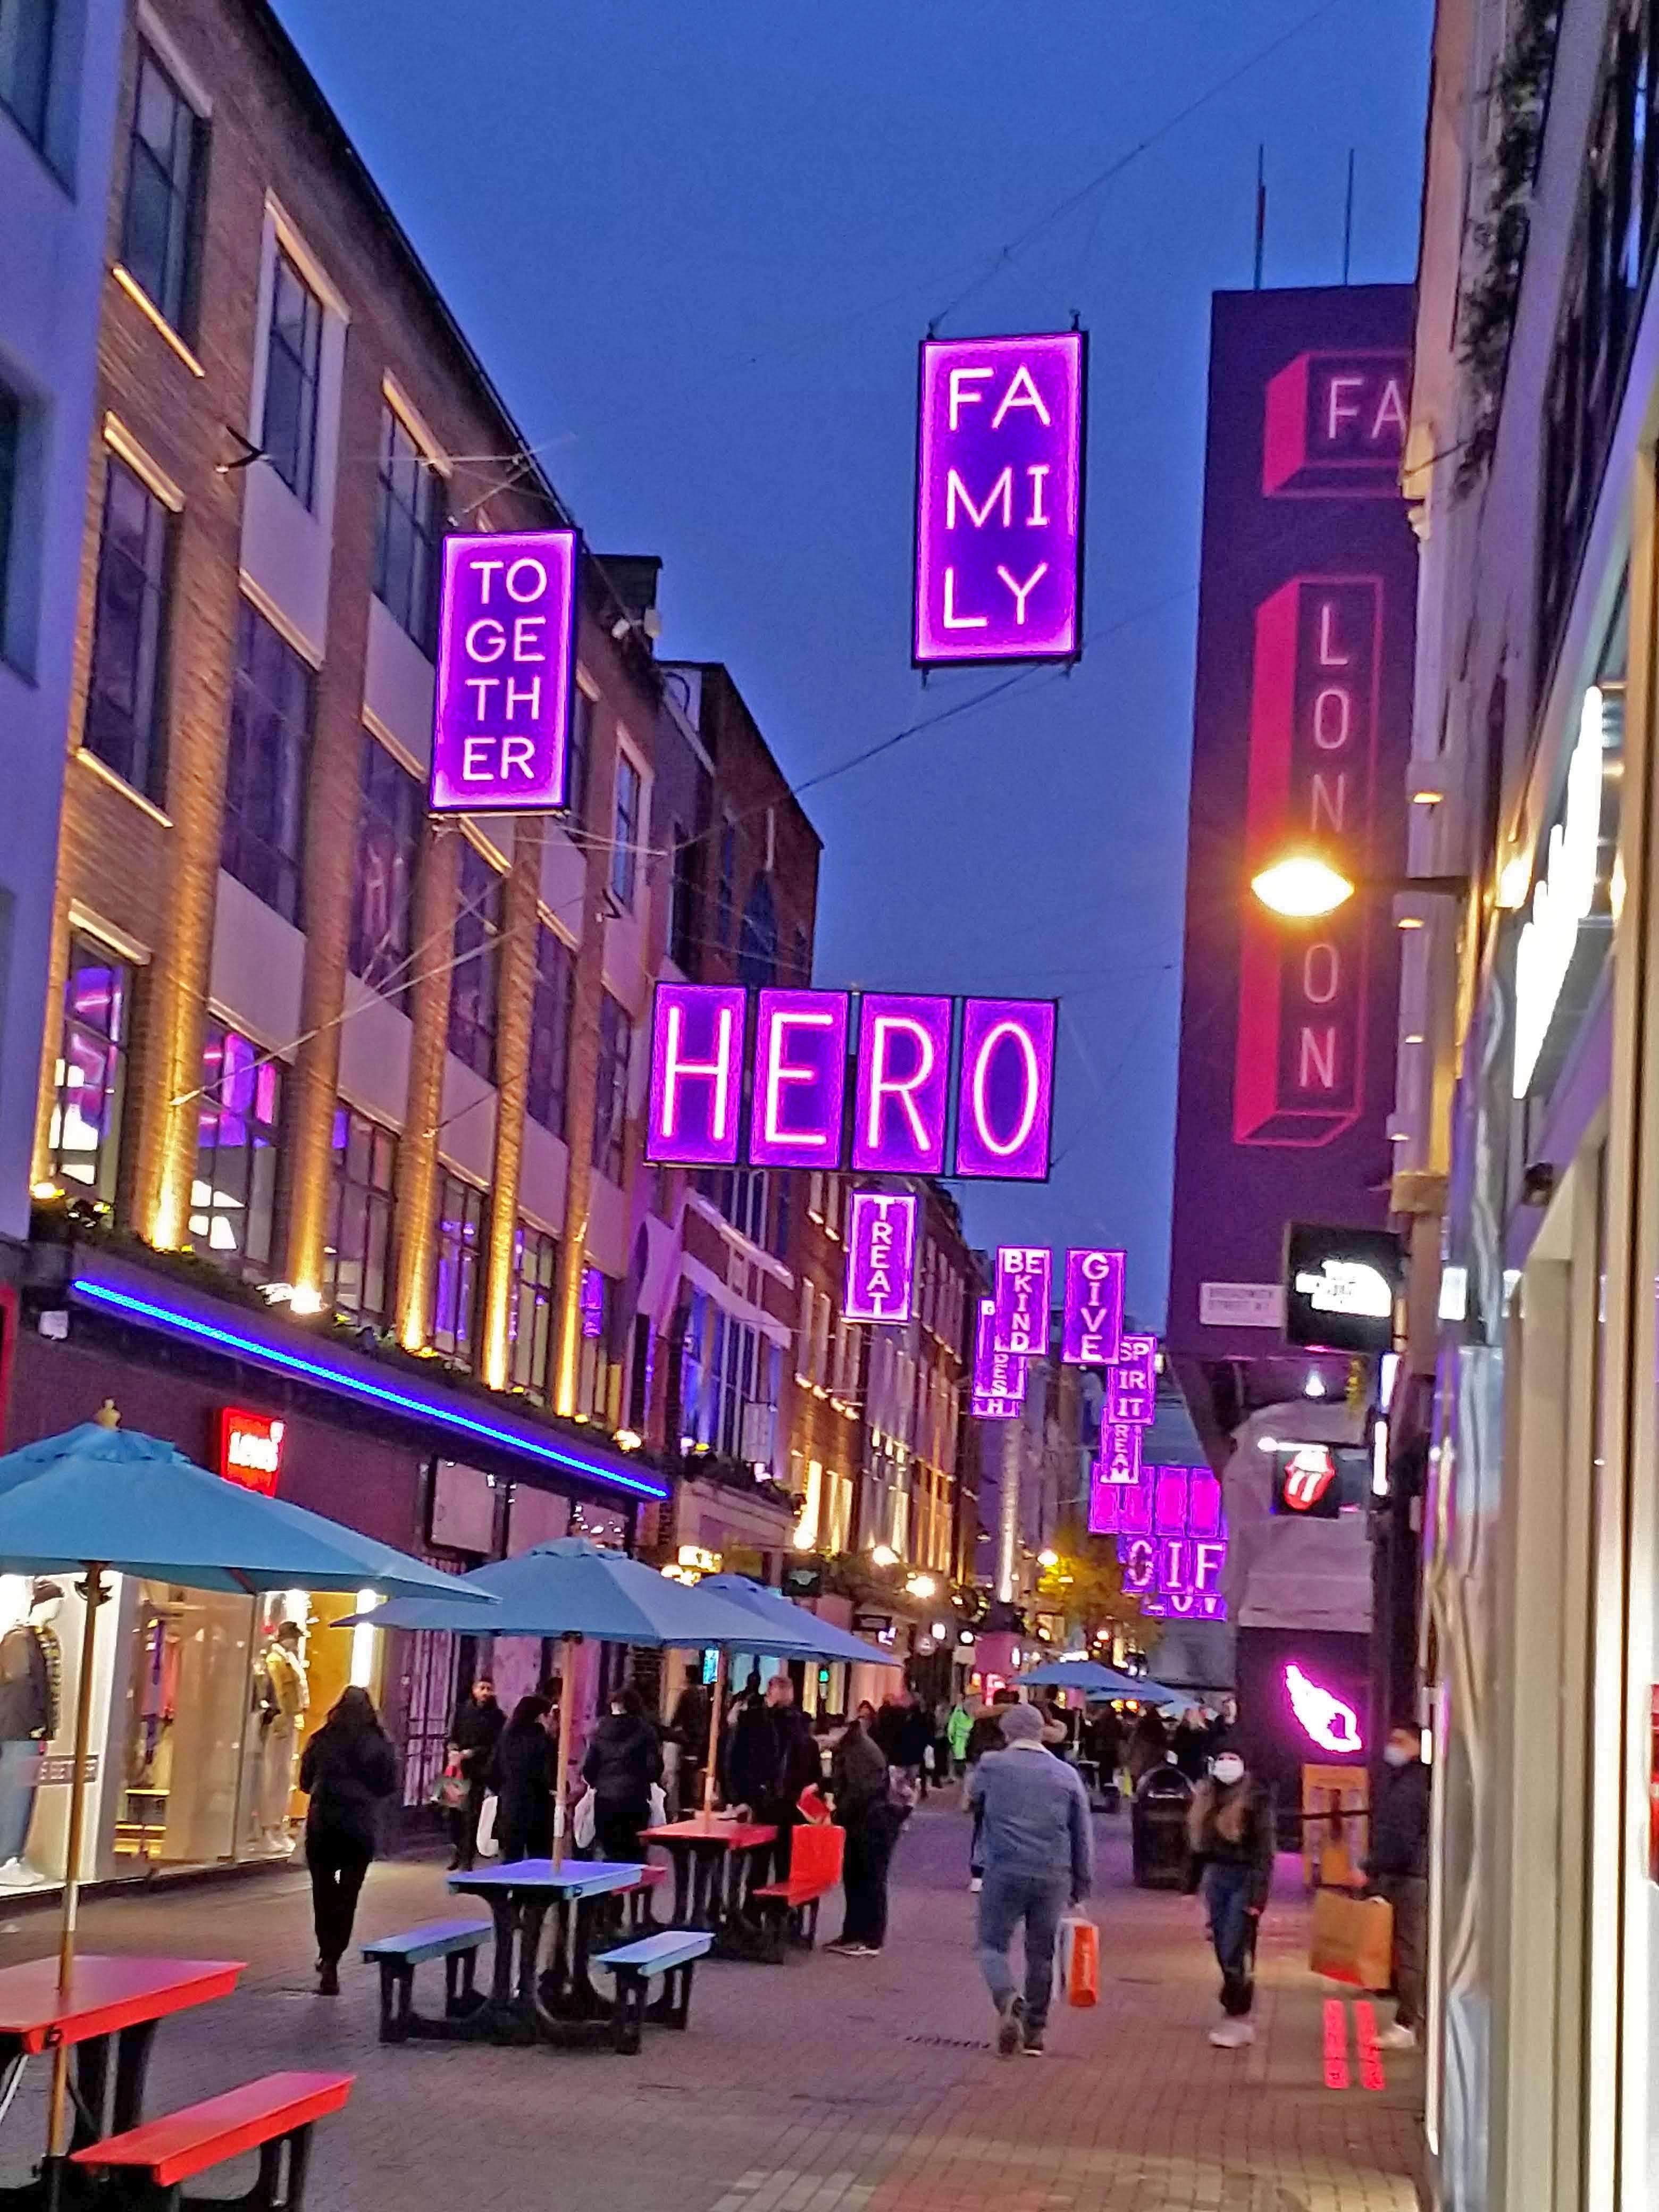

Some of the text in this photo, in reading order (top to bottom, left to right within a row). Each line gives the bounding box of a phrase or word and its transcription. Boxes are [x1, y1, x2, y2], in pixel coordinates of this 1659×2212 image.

[950, 365, 1051, 431] FA
[946, 464, 1050, 529] MI
[469, 558, 547, 605] TO
[944, 562, 1048, 629] LY
[465, 616, 546, 663] GE
[466, 676, 541, 721] TH
[462, 735, 535, 782] ER
[1299, 603, 1351, 1089] LONON
[663, 1007, 1038, 1155] HERO
[866, 1197, 895, 1316] TREAT
[1004, 1250, 1045, 1273] BE
[1010, 1274, 1033, 1352] KIND
[1080, 1252, 1110, 1361] GIVE
